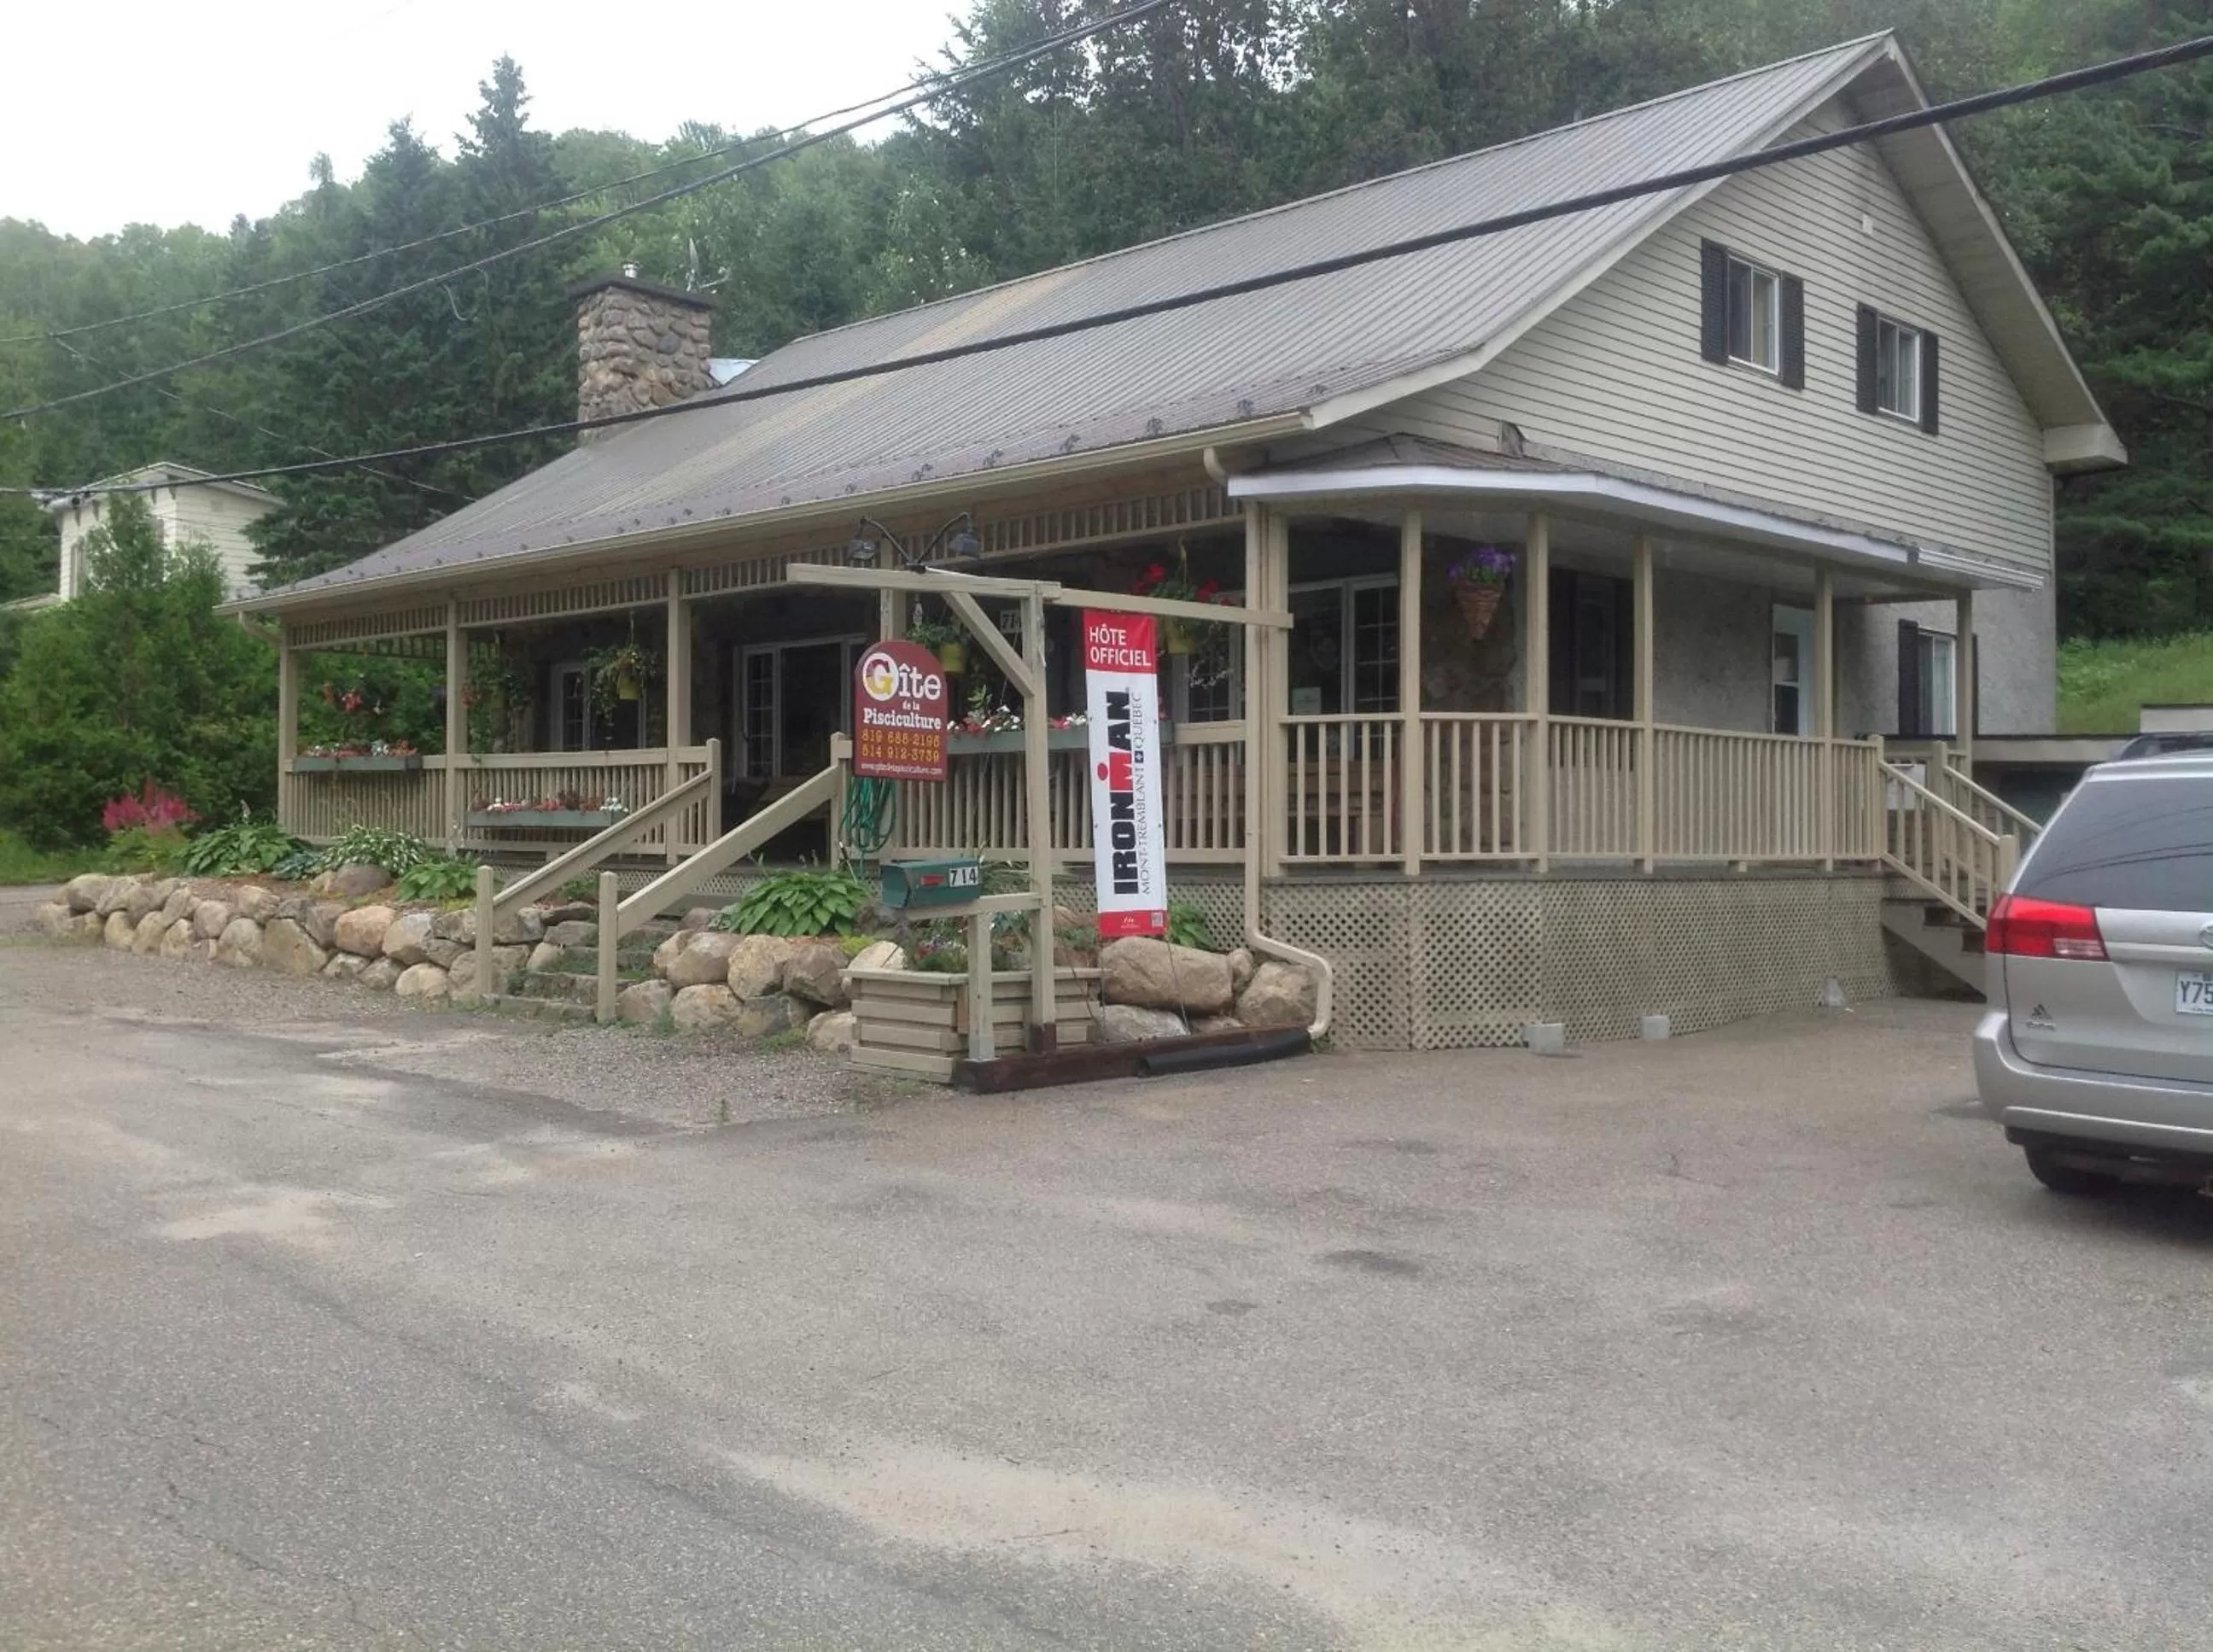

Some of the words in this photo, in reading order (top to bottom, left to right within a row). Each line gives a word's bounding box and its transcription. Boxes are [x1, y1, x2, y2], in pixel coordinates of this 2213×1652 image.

[1089, 624, 1126, 645] HÔTE
[1090, 647, 1152, 666] OFFICIEL
[862, 652, 941, 701] Gîte
[902, 701, 911, 709] de
[913, 701, 920, 710] la
[863, 708, 941, 729] Pisciculture
[1097, 691, 1139, 894] IRONMAN
[1135, 767, 1150, 895] MONT-TREMBLANT
[950, 868, 977, 885] 714
[2181, 980, 2213, 1004] Y75
